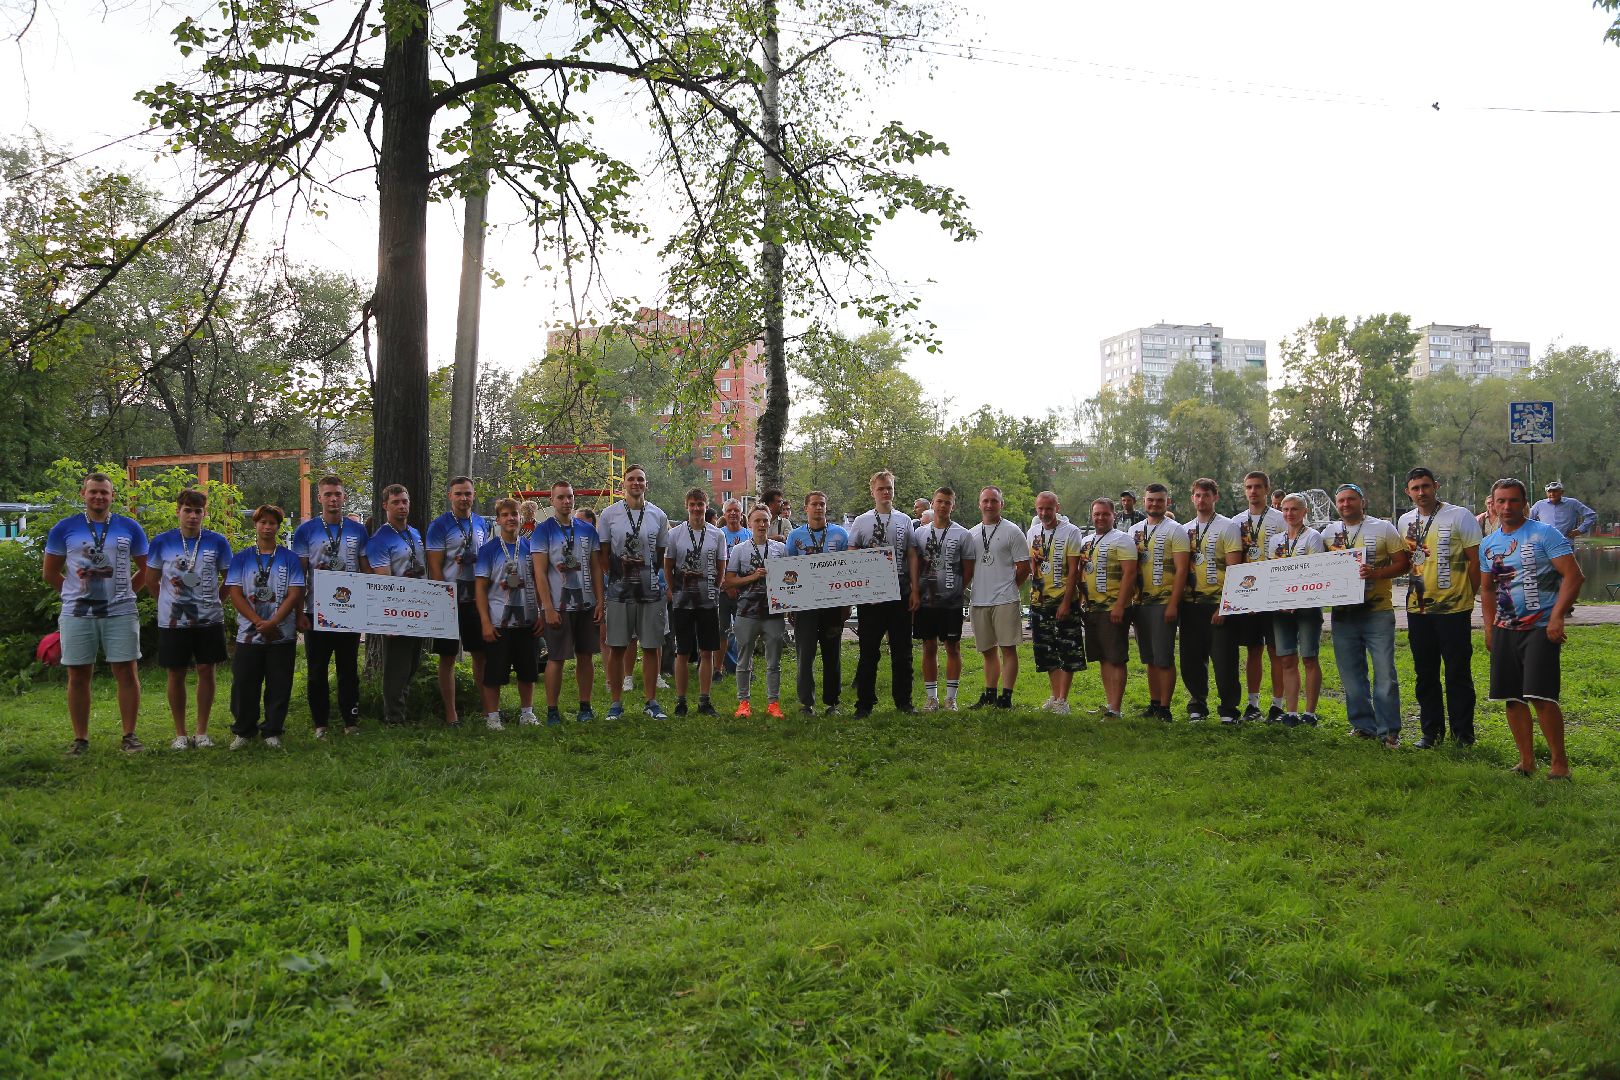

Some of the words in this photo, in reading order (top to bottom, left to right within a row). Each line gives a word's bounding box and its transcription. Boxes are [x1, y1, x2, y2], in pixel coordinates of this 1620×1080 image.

[1437, 524, 1452, 590] СУПЕРКУБОК
[1520, 543, 1541, 611] СУПЕРКУБОК
[829, 582, 841, 590] 70
[845, 580, 863, 588] 000
[1302, 582, 1323, 591] 000
[384, 609, 398, 617] 50
[401, 609, 421, 618] 000
